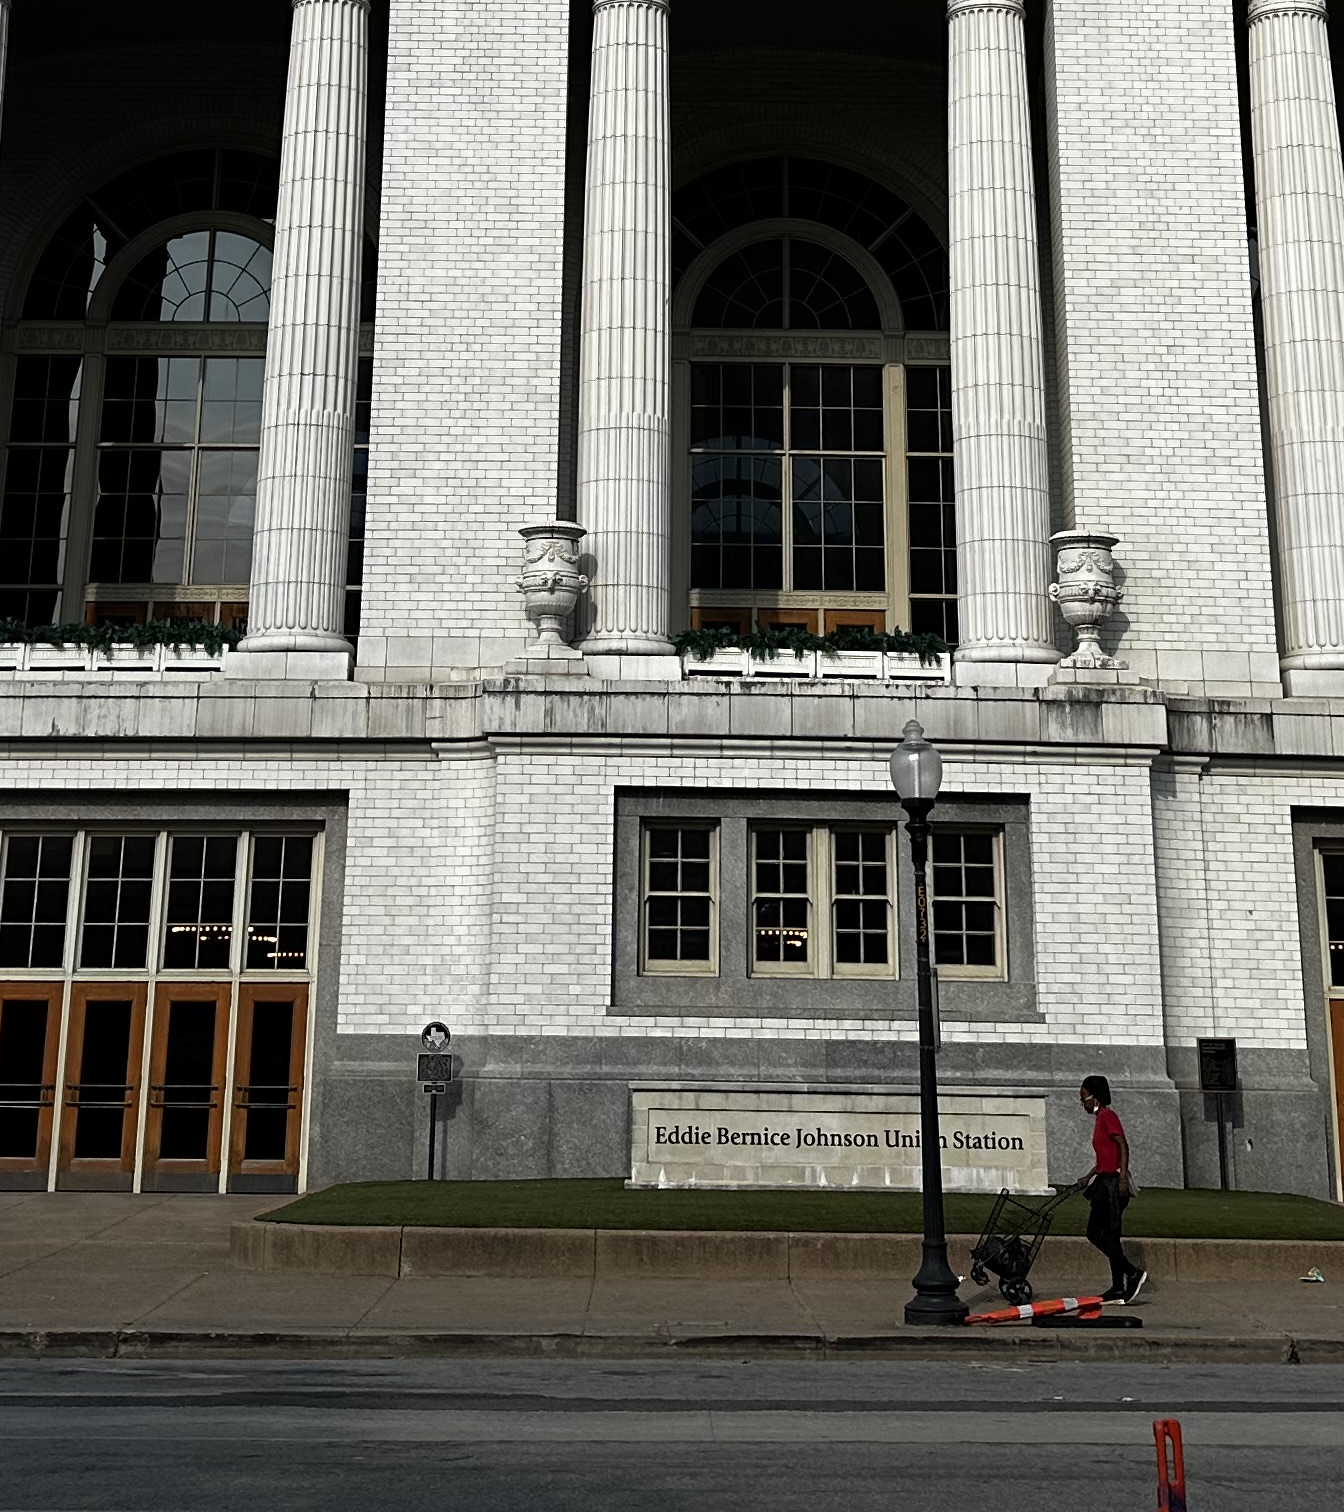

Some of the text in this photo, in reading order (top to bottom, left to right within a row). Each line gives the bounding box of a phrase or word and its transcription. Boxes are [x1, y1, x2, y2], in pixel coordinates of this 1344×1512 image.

[655, 1125, 1024, 1150] Eddie Bernice Johnson Unin Station
